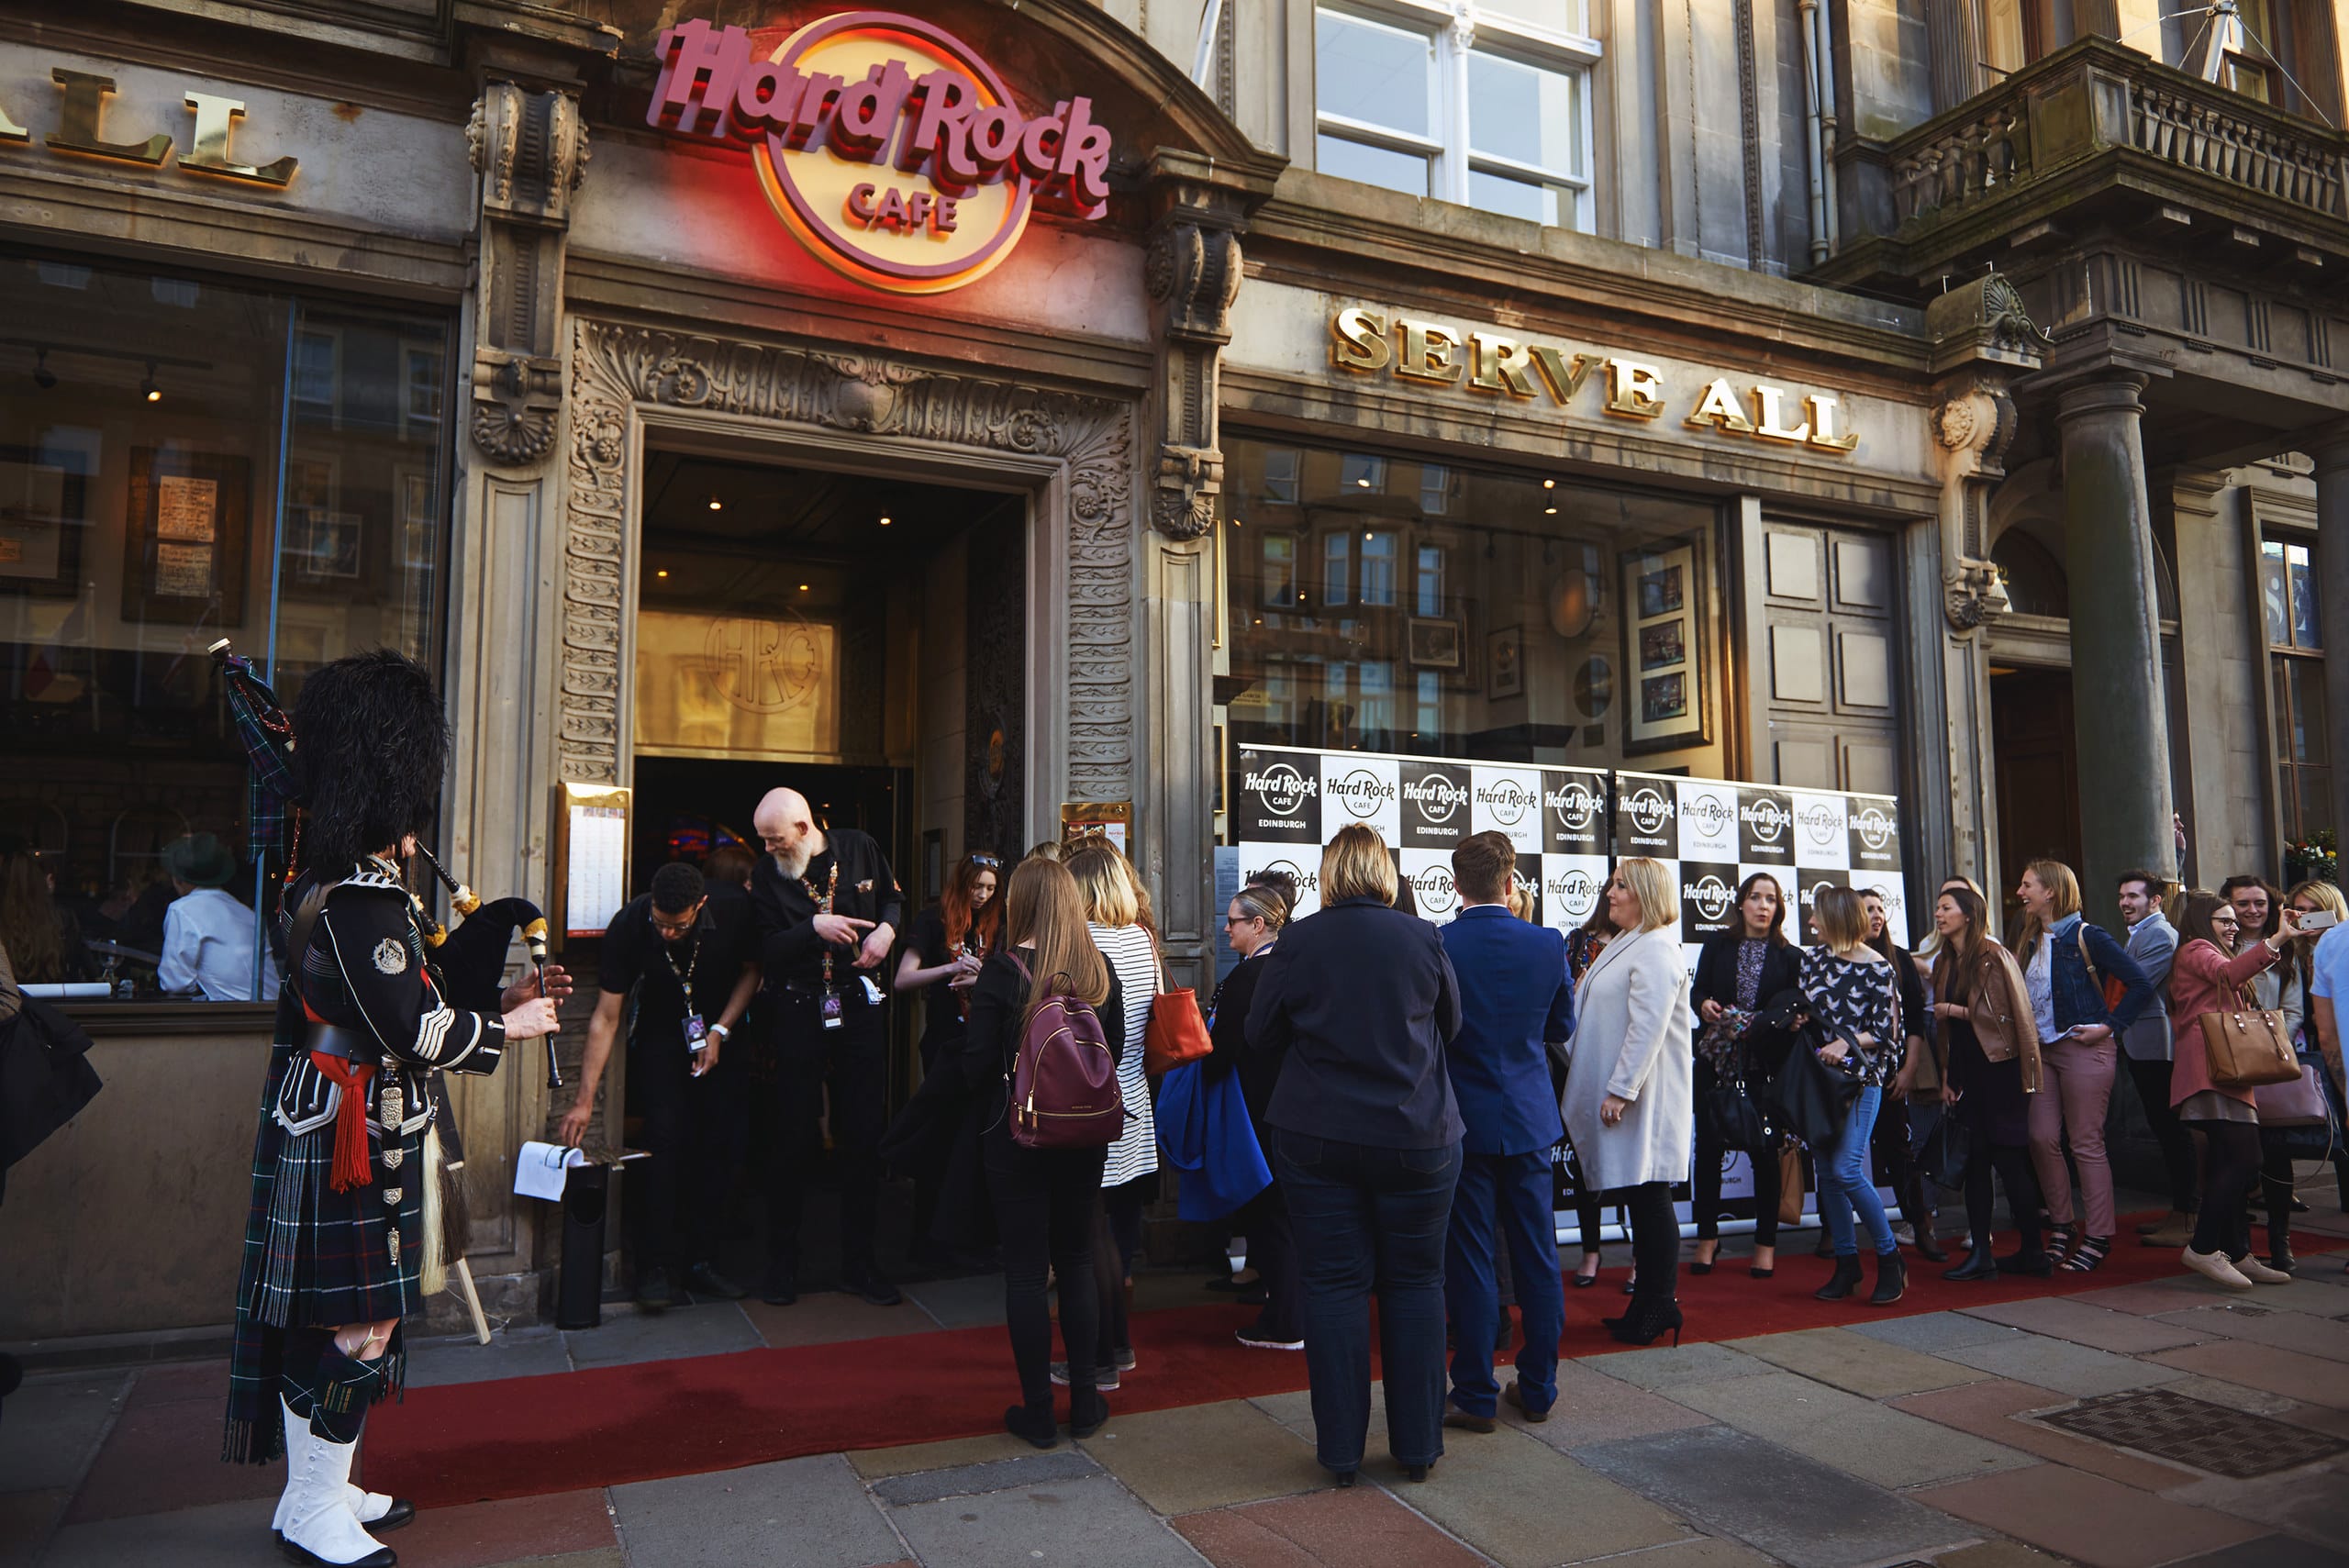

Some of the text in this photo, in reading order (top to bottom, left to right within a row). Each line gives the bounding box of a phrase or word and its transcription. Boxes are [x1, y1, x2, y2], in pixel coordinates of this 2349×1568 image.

[0, 67, 298, 186] LL
[648, 18, 1111, 217] Hard Rock
[843, 183, 957, 239] CAFE
[1334, 306, 1860, 450] SERVE ALL
[1244, 773, 1318, 797] Hard Rock
[1327, 778, 1395, 801] Hard Rock
[1403, 782, 1468, 806] Hard Rock
[1272, 796, 1292, 806] CAFE
[1353, 801, 1372, 809] CAFE
[1476, 787, 1537, 808] Hard Rock
[1544, 791, 1604, 814] Hard Rock
[1619, 795, 1675, 818] Hard Rock
[1428, 806, 1446, 815] CAFE
[1499, 809, 1515, 817] CAFE
[1566, 812, 1584, 821] CAFE
[1681, 802, 1734, 822] Hard Rock
[1740, 806, 1791, 828] Hard Rock
[1258, 818, 1306, 828] EDINBURGH
[1416, 826, 1458, 836] EDINBURGH
[1640, 817, 1656, 826] CAFE
[1798, 811, 1843, 831] Hard Rock
[1849, 814, 1897, 836] Hard Rock
[1555, 832, 1595, 842] EDINBURGH
[1630, 836, 1667, 846] EDINBURGH
[1693, 841, 1727, 850] EDINBURGH
[1439, 875, 1454, 895] Ro
[1547, 879, 1576, 895] Hard
[1683, 884, 1737, 904] Hard Rock
[1430, 896, 1446, 905] CAFE
[1569, 899, 1586, 907] CAFE
[1705, 904, 1720, 912] CAFE
